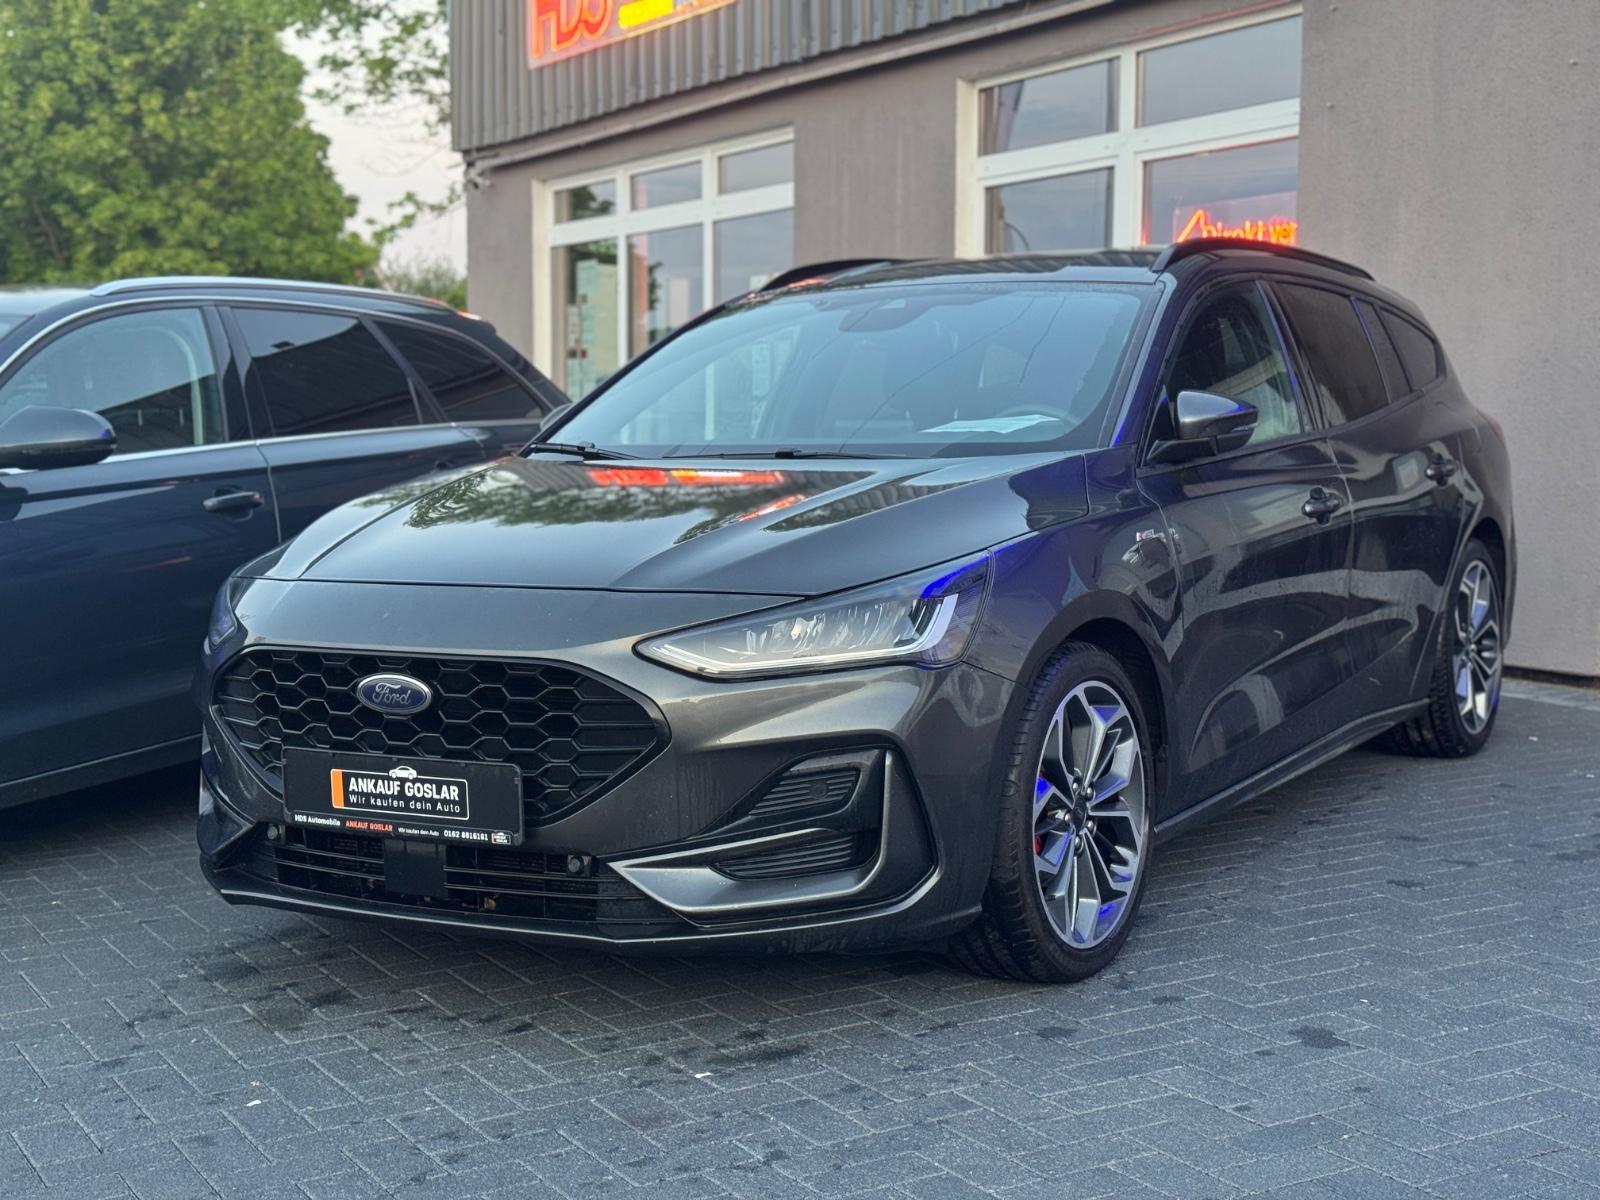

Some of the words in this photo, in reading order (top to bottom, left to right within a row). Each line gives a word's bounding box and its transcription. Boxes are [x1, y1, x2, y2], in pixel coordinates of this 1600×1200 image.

[372, 682, 411, 704] Ford
[349, 777, 401, 796] ANKAUF
[404, 782, 459, 800] GOSLAR
[349, 794, 366, 804] Wir
[370, 796, 405, 808] kaufen
[409, 800, 432, 811] dein
[436, 802, 460, 813] Auto
[307, 816, 341, 827] Automobile
[345, 820, 368, 830] ANKAUF
[369, 822, 393, 832] GOSLAR
